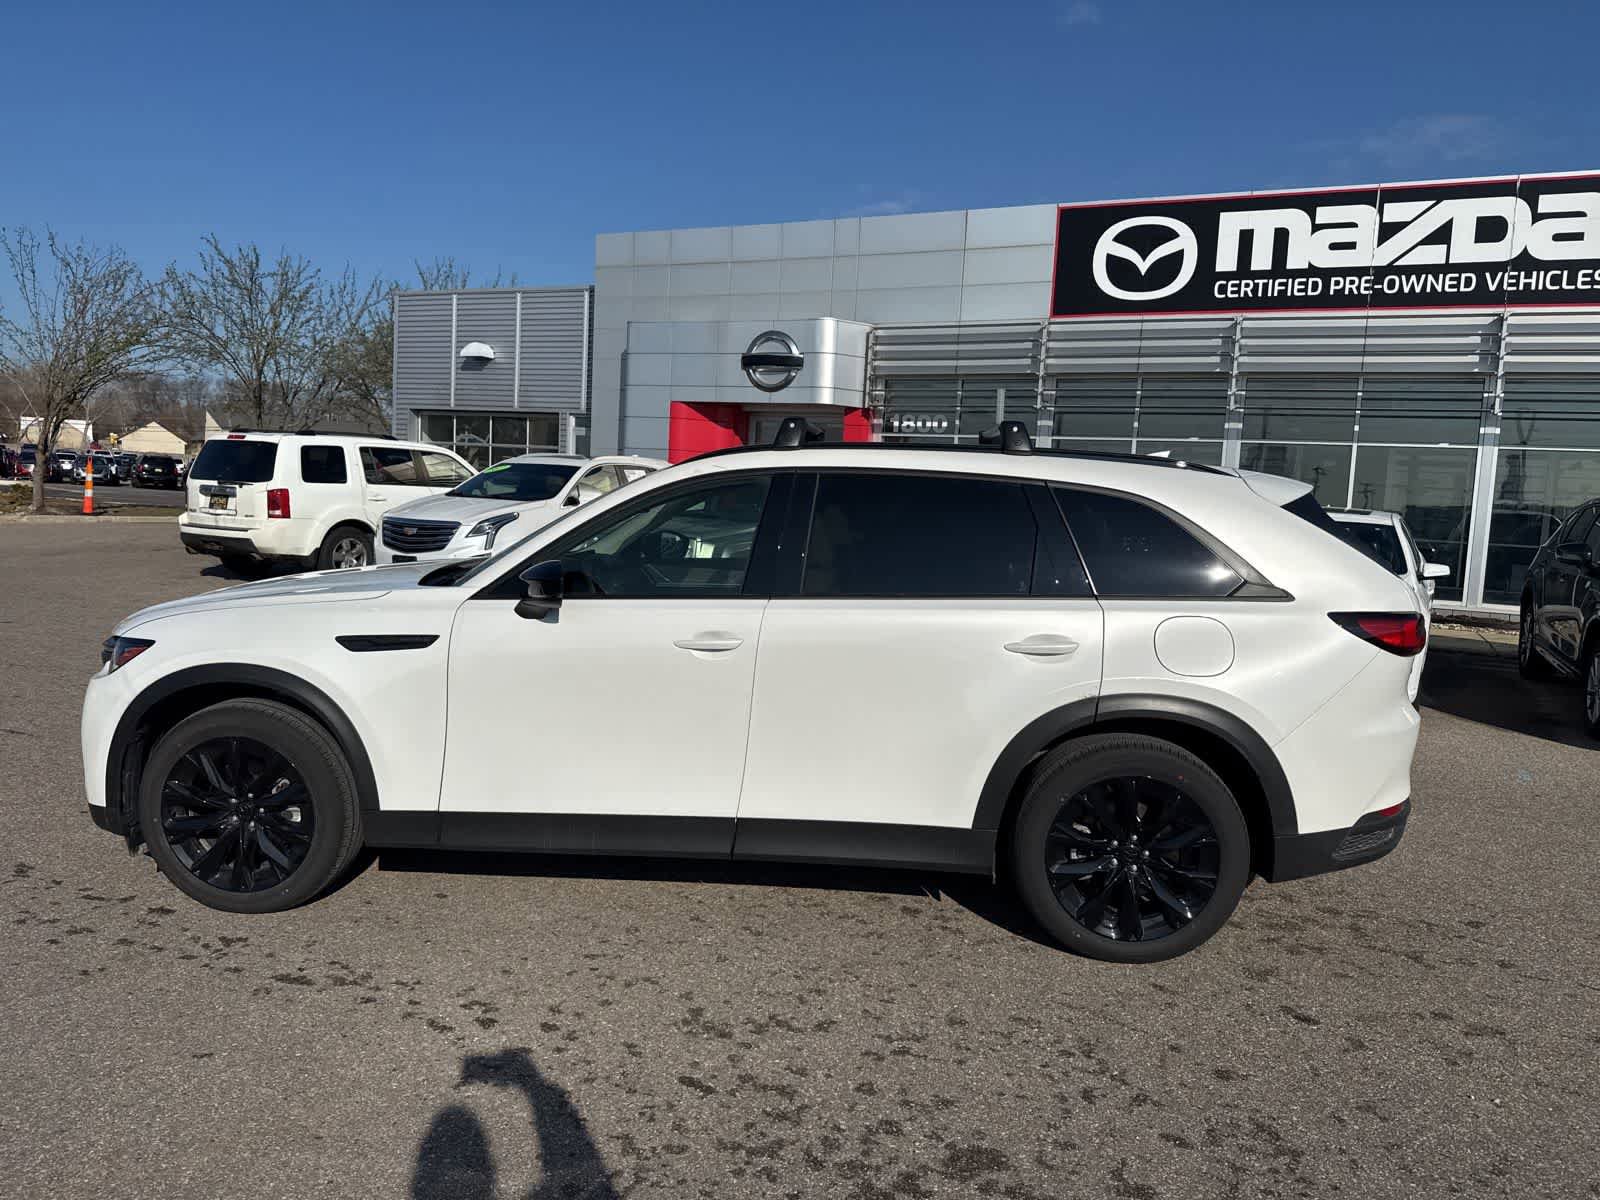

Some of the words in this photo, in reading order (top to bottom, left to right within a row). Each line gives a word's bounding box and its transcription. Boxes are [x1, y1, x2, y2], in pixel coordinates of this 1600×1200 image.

[1213, 278, 1323, 299] CERTIFIED
[1329, 272, 1477, 296] PRE-OWNED
[890, 414, 948, 433] 1800
